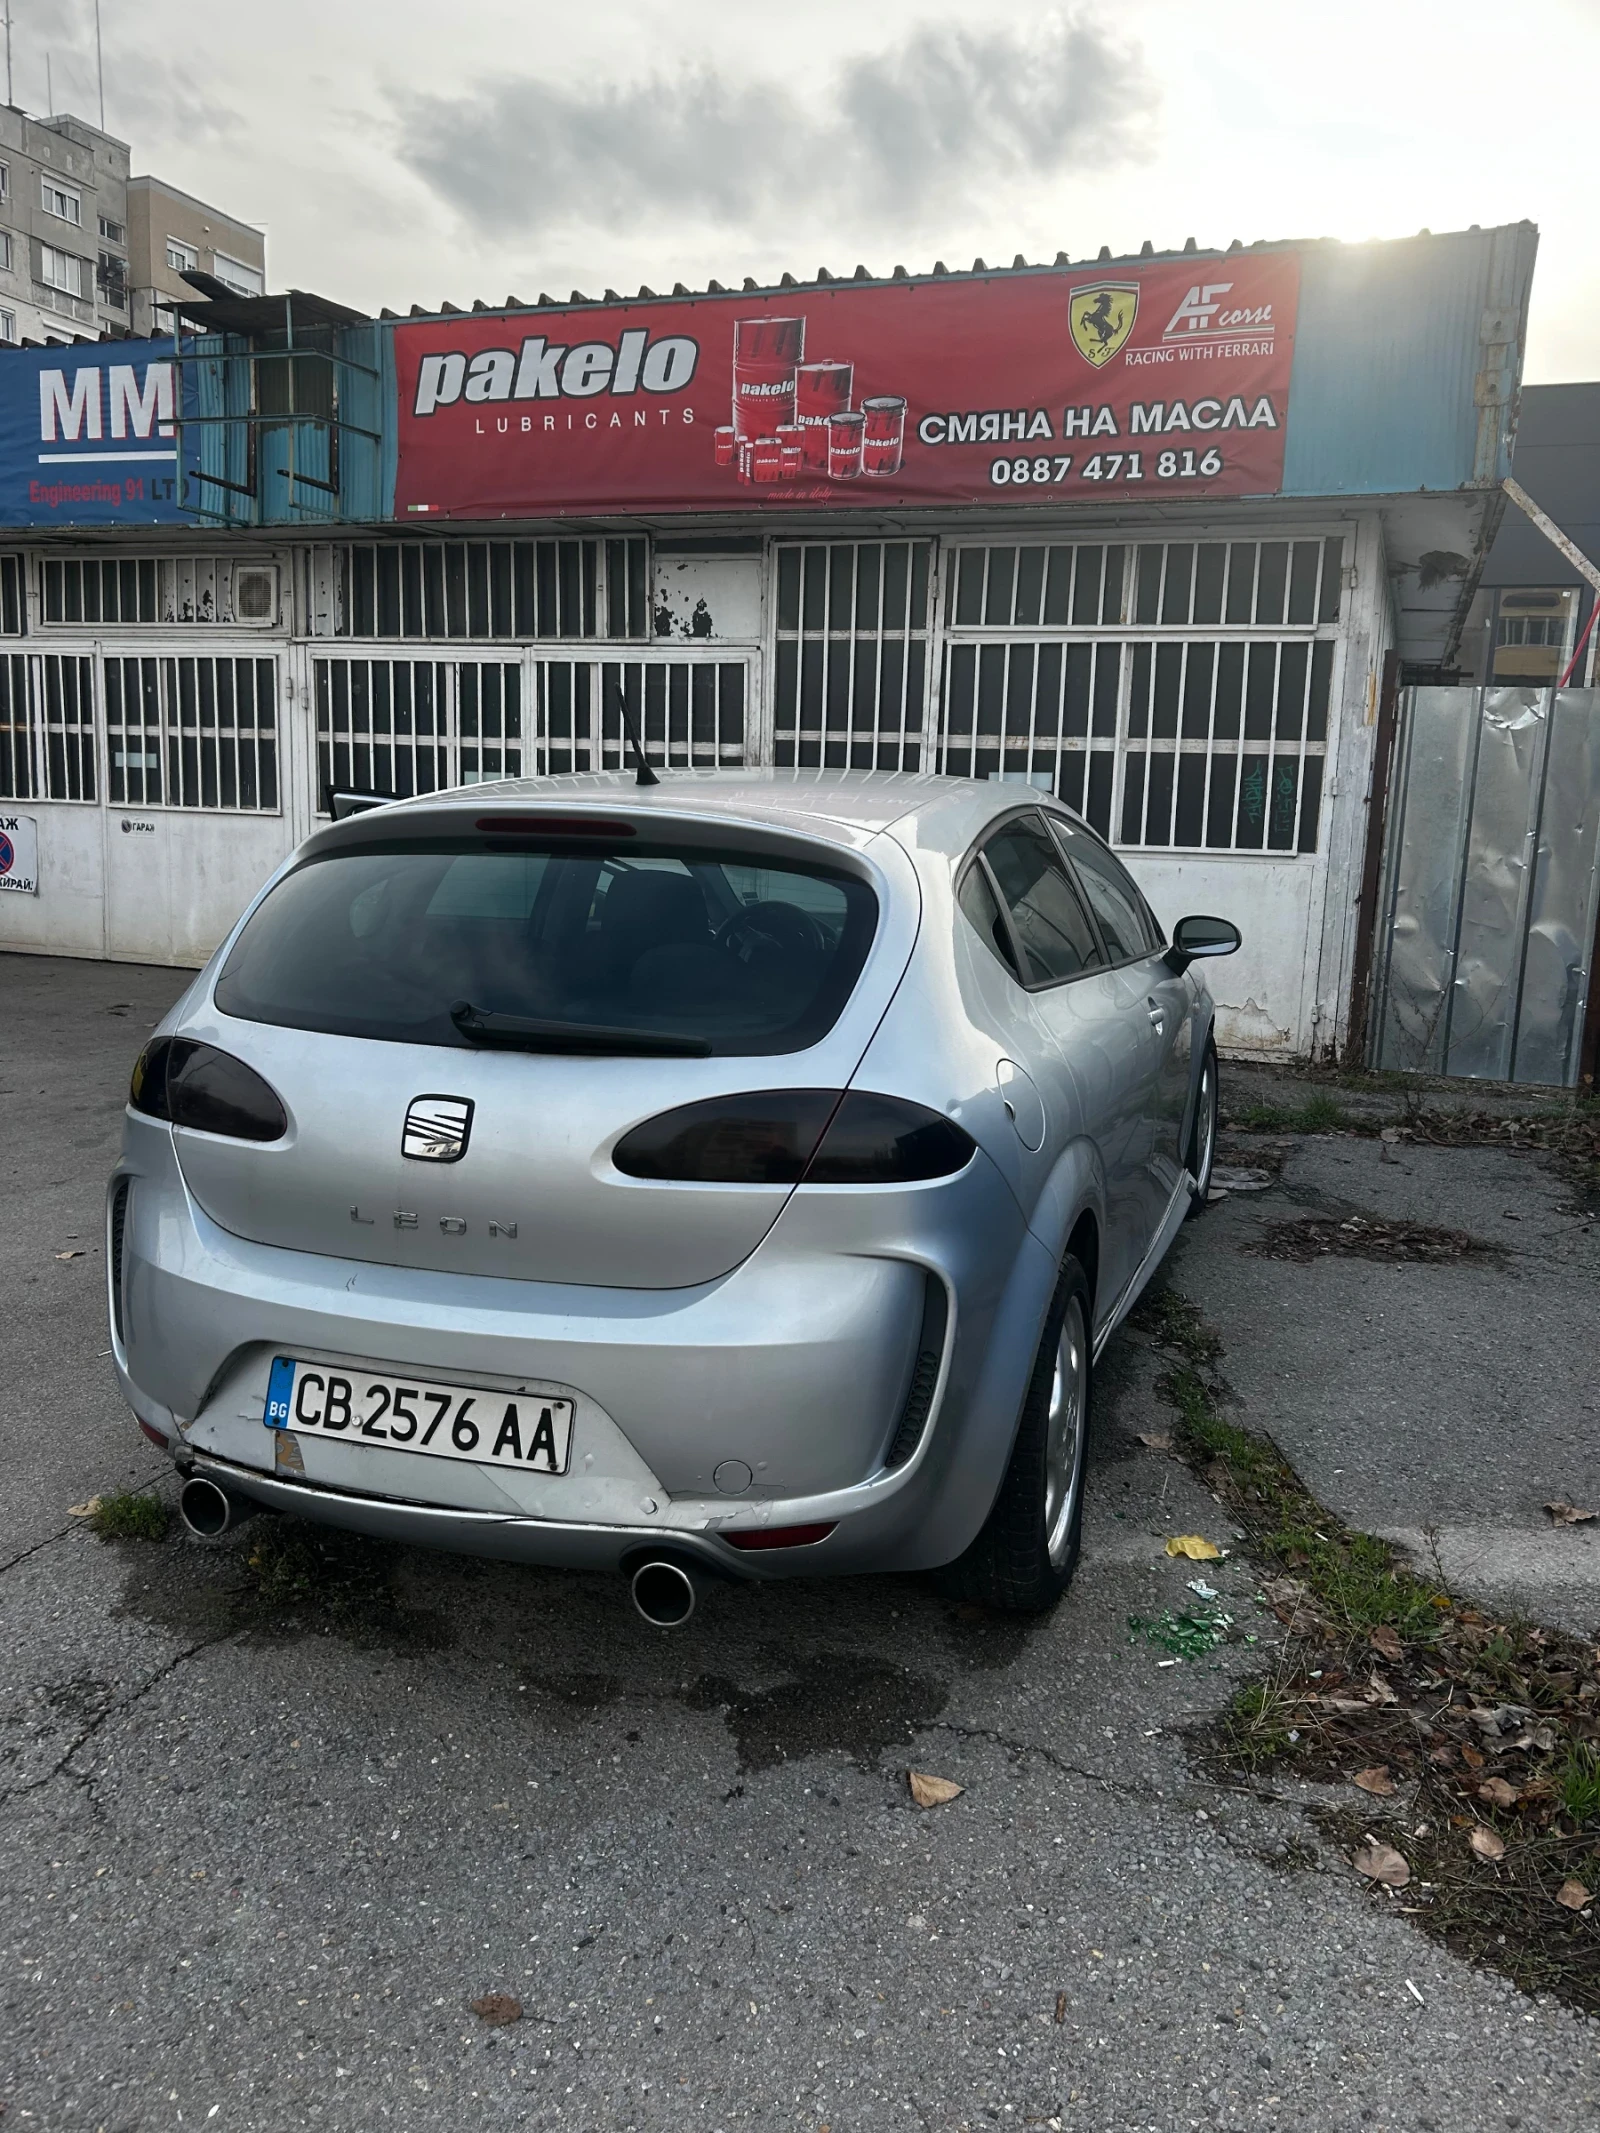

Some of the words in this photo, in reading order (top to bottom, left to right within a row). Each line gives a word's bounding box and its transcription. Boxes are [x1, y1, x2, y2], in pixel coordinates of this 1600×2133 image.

[1125, 348, 1175, 366] RACING
[1178, 345, 1213, 361] WITH
[1217, 342, 1274, 357] FERRARI
[413, 327, 700, 418] pakelo
[741, 380, 795, 396] pakelo
[39, 363, 176, 441] MM
[475, 407, 695, 434] LUBRICANTS
[918, 408, 1054, 446] СМЯНА
[1065, 405, 1119, 439] НА
[1130, 397, 1278, 437] МАСЛА
[990, 457, 1072, 485] 0887
[1082, 453, 1144, 481] 471
[1157, 449, 1222, 477] 816
[29, 480, 122, 508] Engineering
[125, 478, 144, 501] 91
[350, 1205, 518, 1239] LEON
[269, 1401, 287, 1418] BG
[295, 1373, 352, 1431] CB
[362, 1384, 480, 1451] 2576
[491, 1403, 557, 1464] AA
